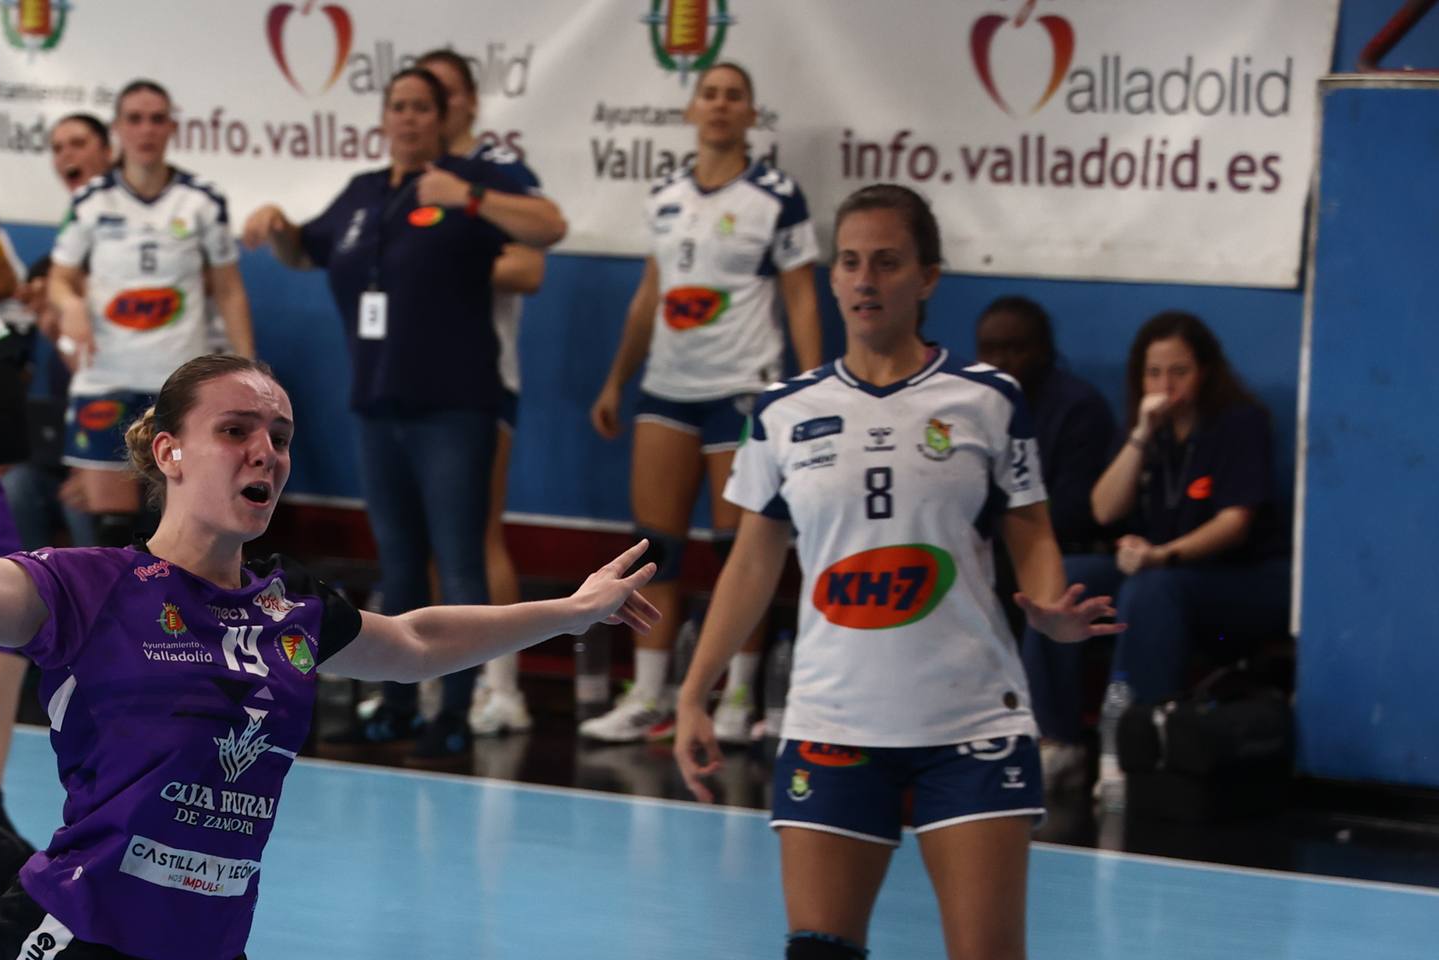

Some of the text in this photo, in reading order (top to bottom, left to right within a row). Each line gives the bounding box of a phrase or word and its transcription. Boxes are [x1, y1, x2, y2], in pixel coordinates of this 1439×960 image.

[840, 129, 1282, 193] info.valladolid.es
[865, 466, 893, 519] 8
[160, 781, 274, 819] CAJA RURAL
[173, 808, 200, 825] DE
[131, 843, 208, 875] CASTILLA
[217, 863, 226, 881] Y
